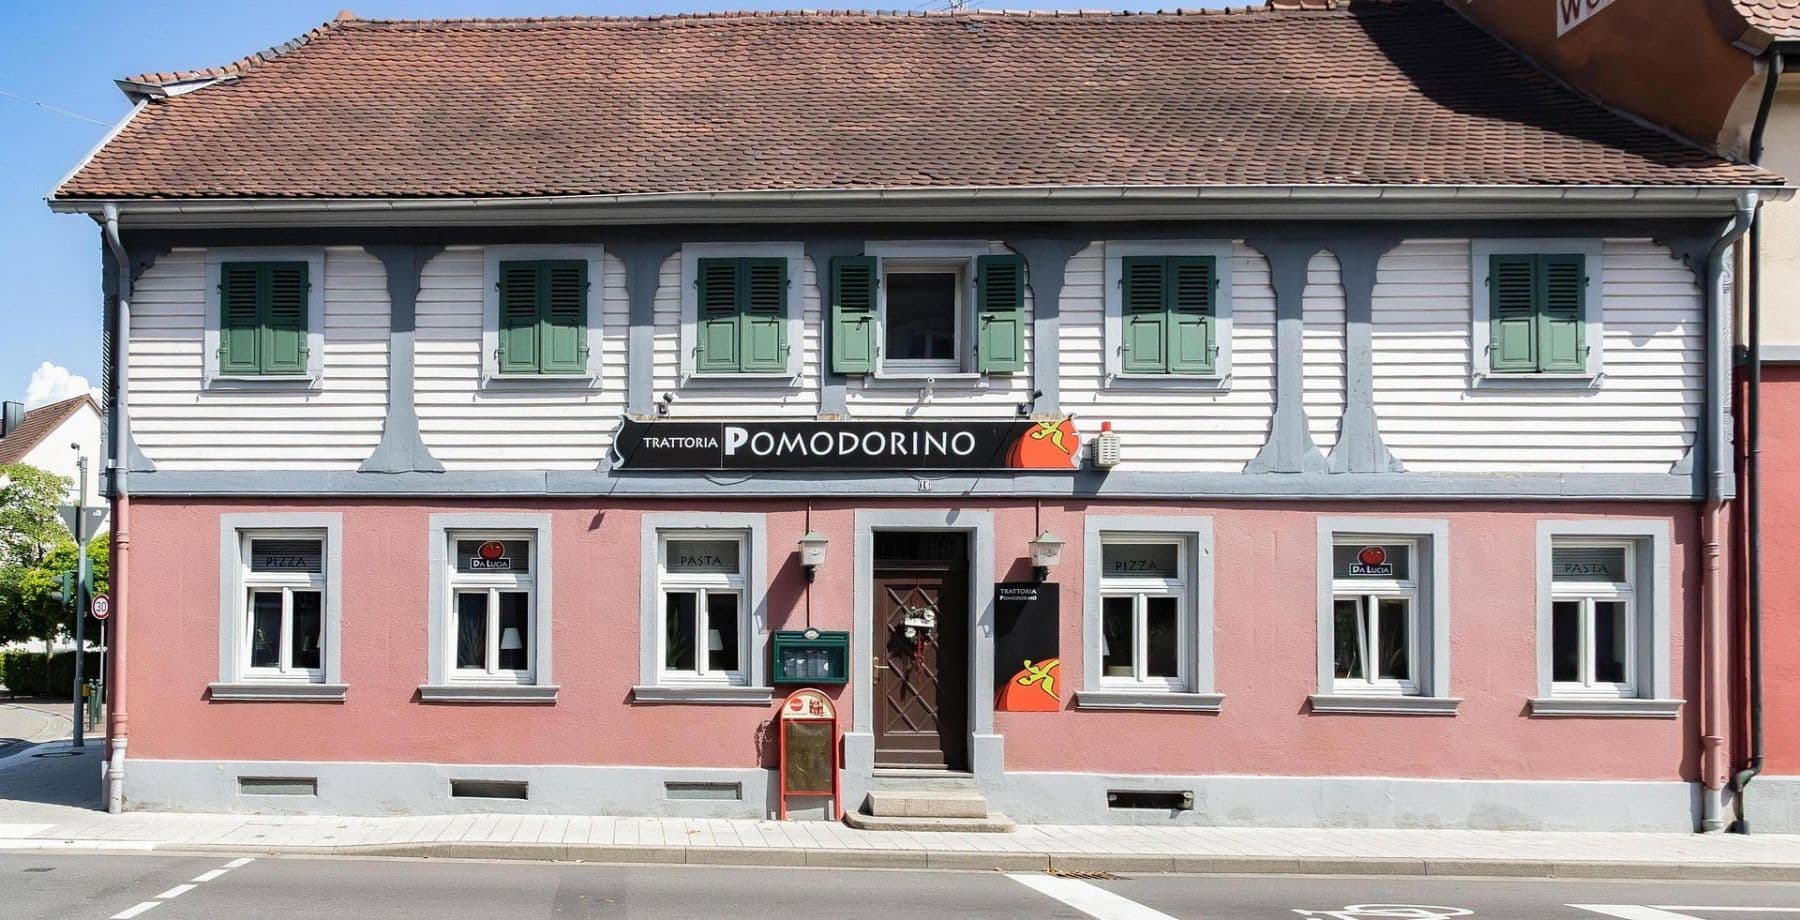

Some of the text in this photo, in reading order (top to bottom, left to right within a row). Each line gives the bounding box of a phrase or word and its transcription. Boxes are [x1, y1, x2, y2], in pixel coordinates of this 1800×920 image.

[642, 426, 976, 456] TRATTORIA POMODORINO
[266, 556, 306, 567] PIZZA
[473, 560, 508, 568] DA LUCIA
[680, 555, 722, 567] PASTA
[1115, 560, 1158, 571] PIZZA
[1352, 565, 1389, 573] DA LUCIA
[1565, 563, 1608, 574] PASTA
[96, 601, 107, 612] 30
